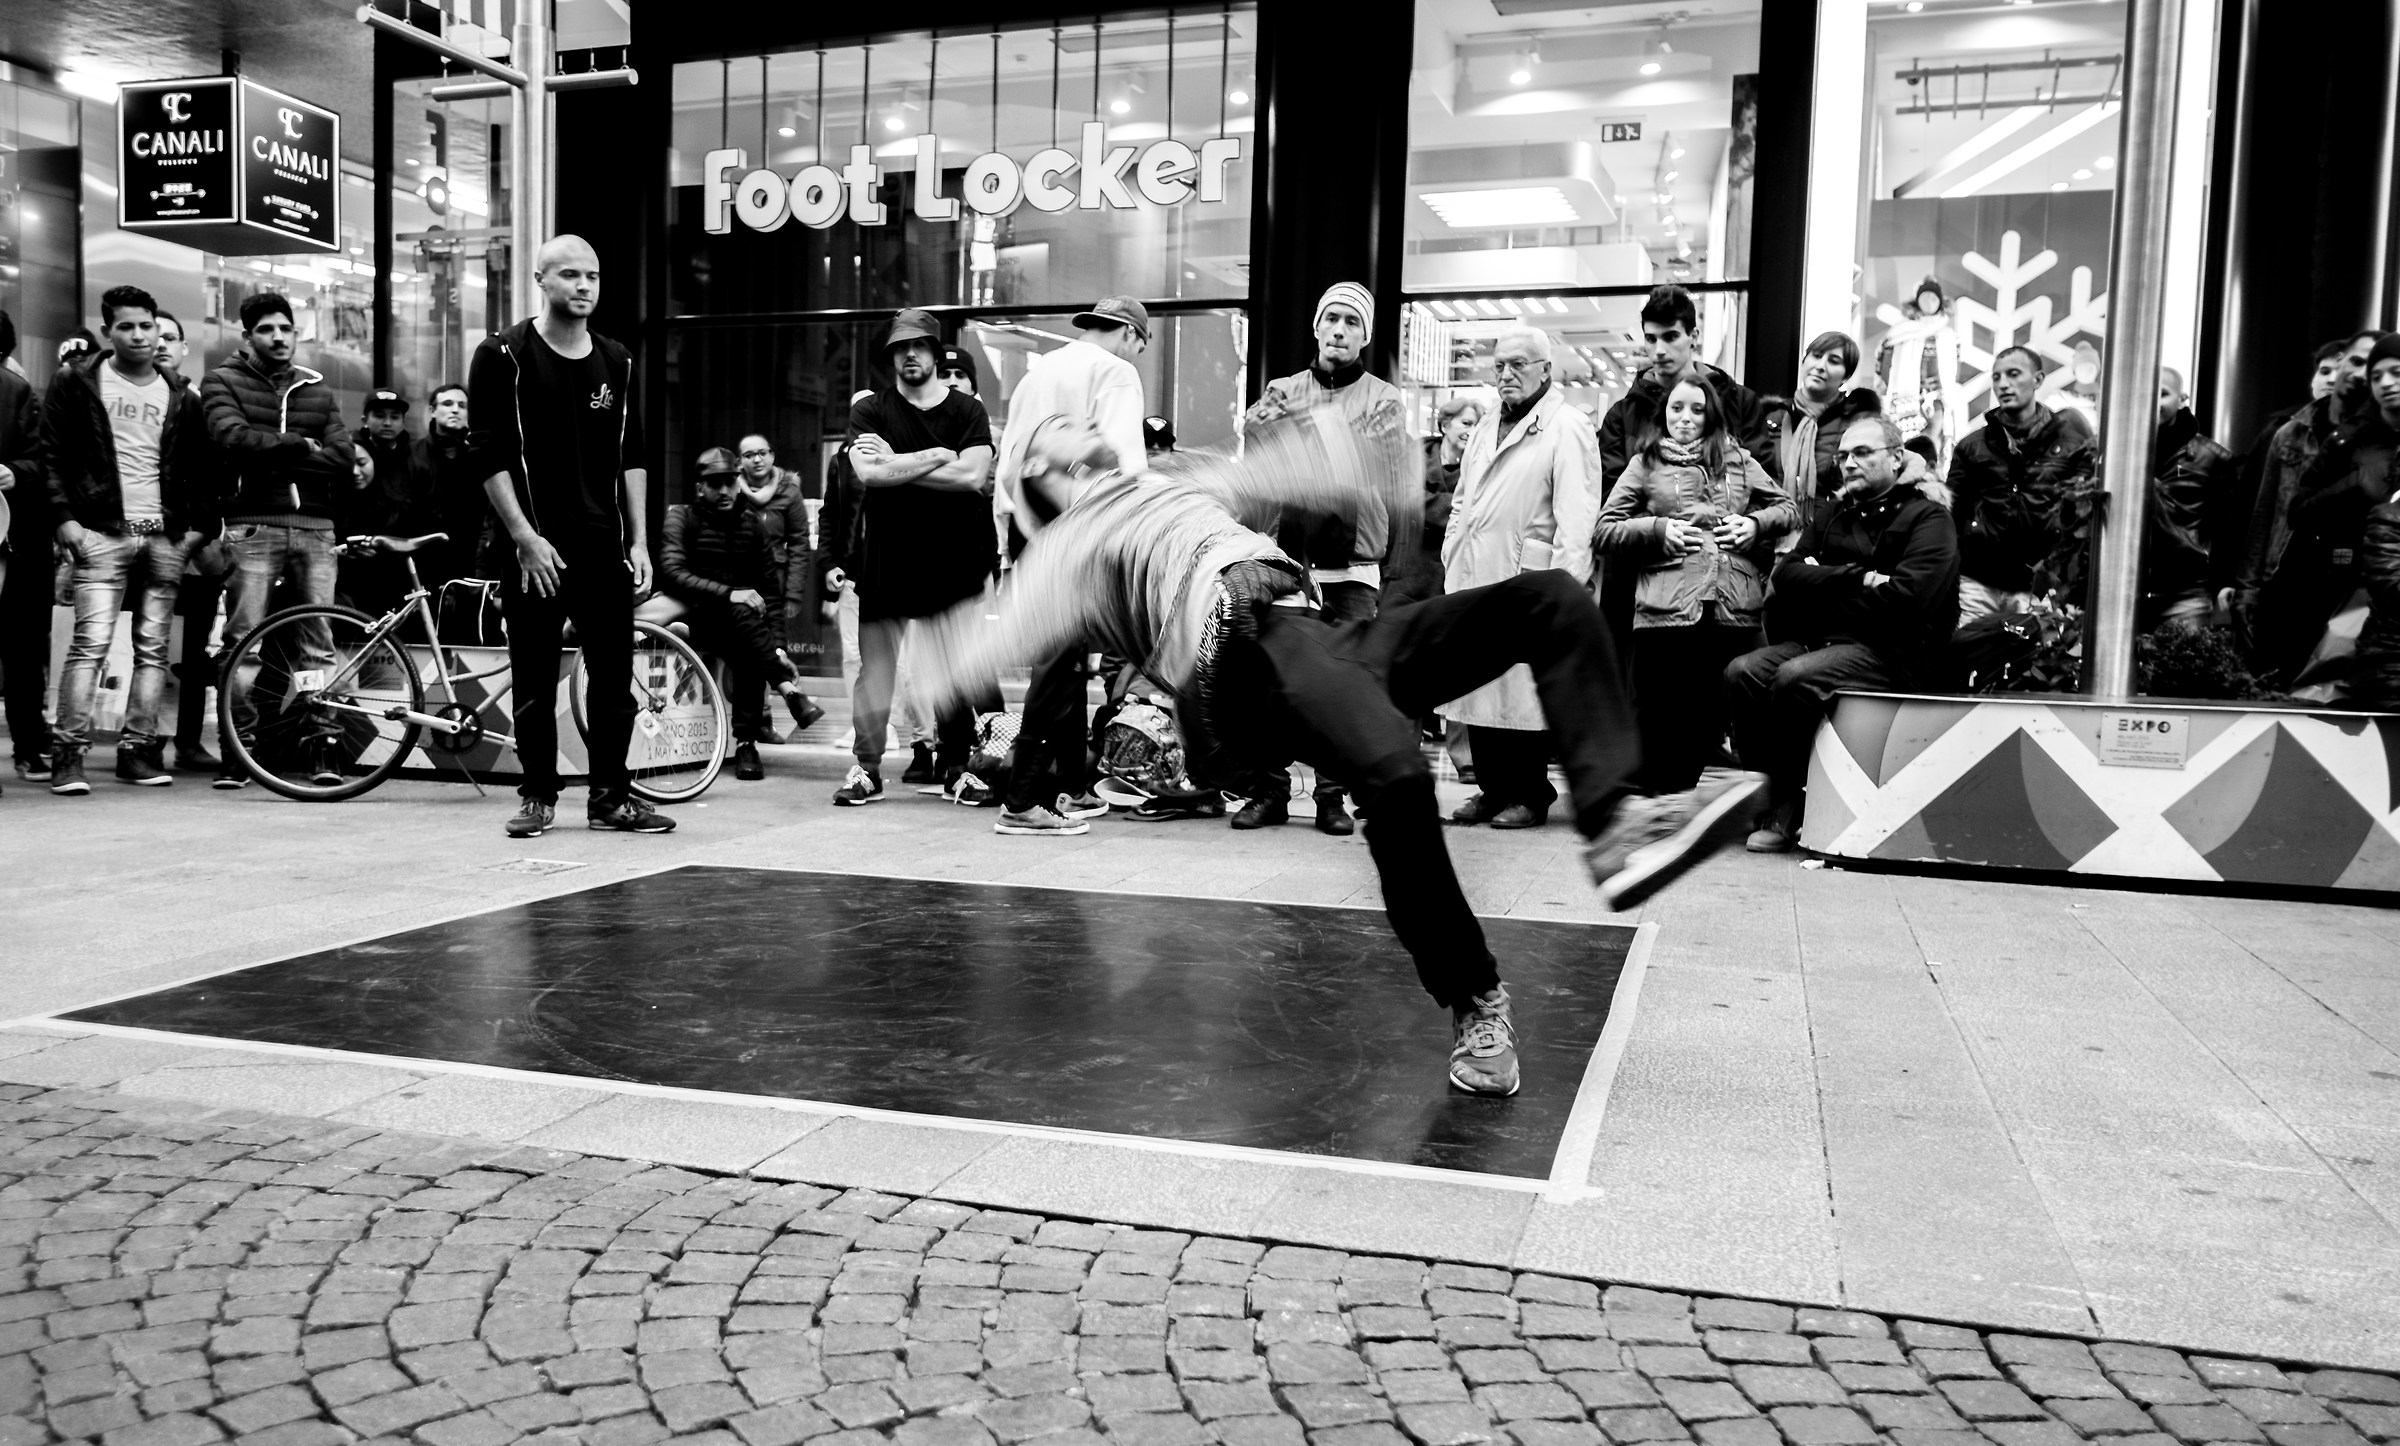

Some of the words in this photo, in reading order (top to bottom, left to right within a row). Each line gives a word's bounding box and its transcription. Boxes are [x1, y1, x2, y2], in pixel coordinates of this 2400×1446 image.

[131, 129, 223, 158] CANALI
[252, 135, 328, 181] CANALI
[914, 121, 1241, 222] Locker
[786, 639, 825, 654] ker.eu
[688, 721, 709, 738] 2015
[2118, 719, 2172, 734] EXPO
